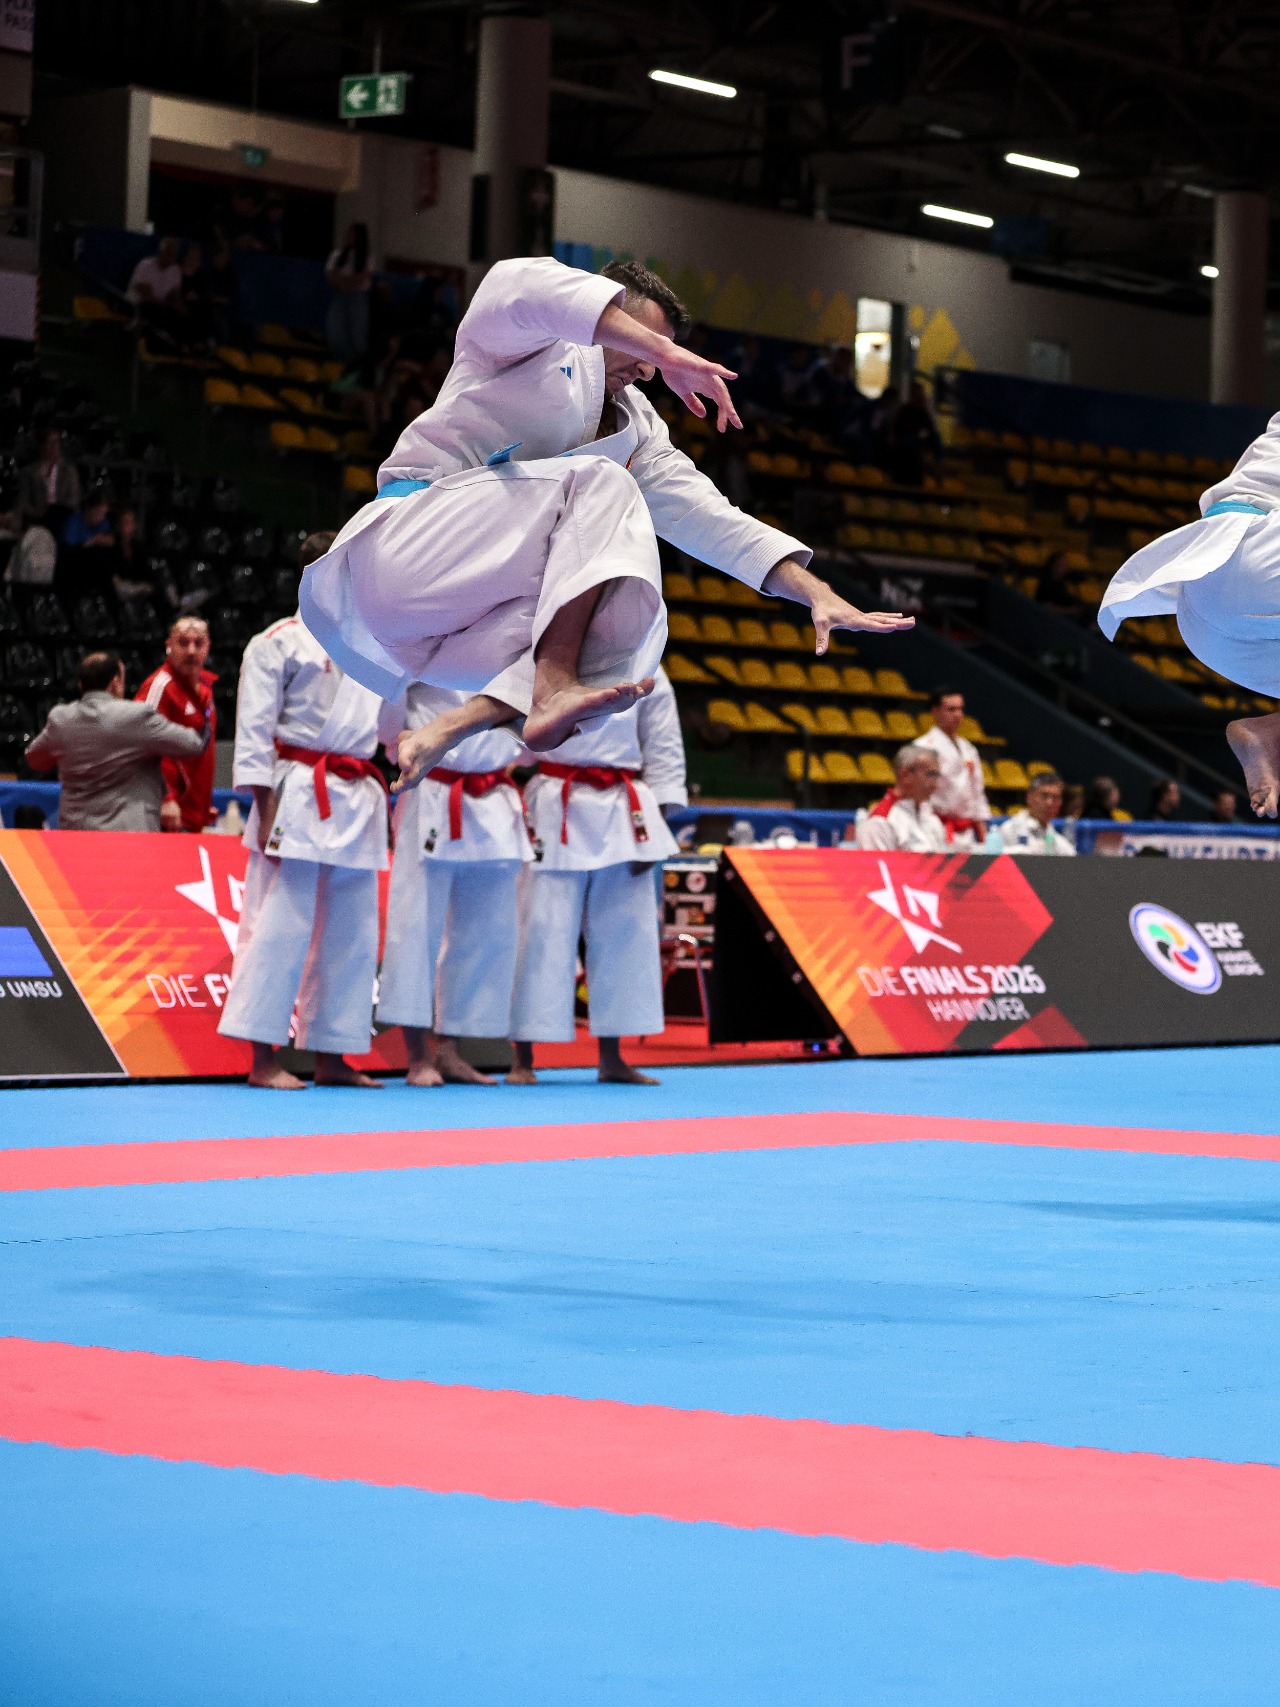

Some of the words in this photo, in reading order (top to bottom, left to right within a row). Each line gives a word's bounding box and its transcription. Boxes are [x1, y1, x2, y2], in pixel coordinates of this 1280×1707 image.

[841, 34, 876, 90] F
[1195, 922, 1244, 948] EKF
[6, 980, 63, 998] UNSU
[145, 973, 207, 1008] DIE
[856, 966, 906, 997] DIE
[900, 965, 990, 995] FINALS
[981, 965, 1047, 994] 2026
[926, 997, 1031, 1022] HANNOVER
